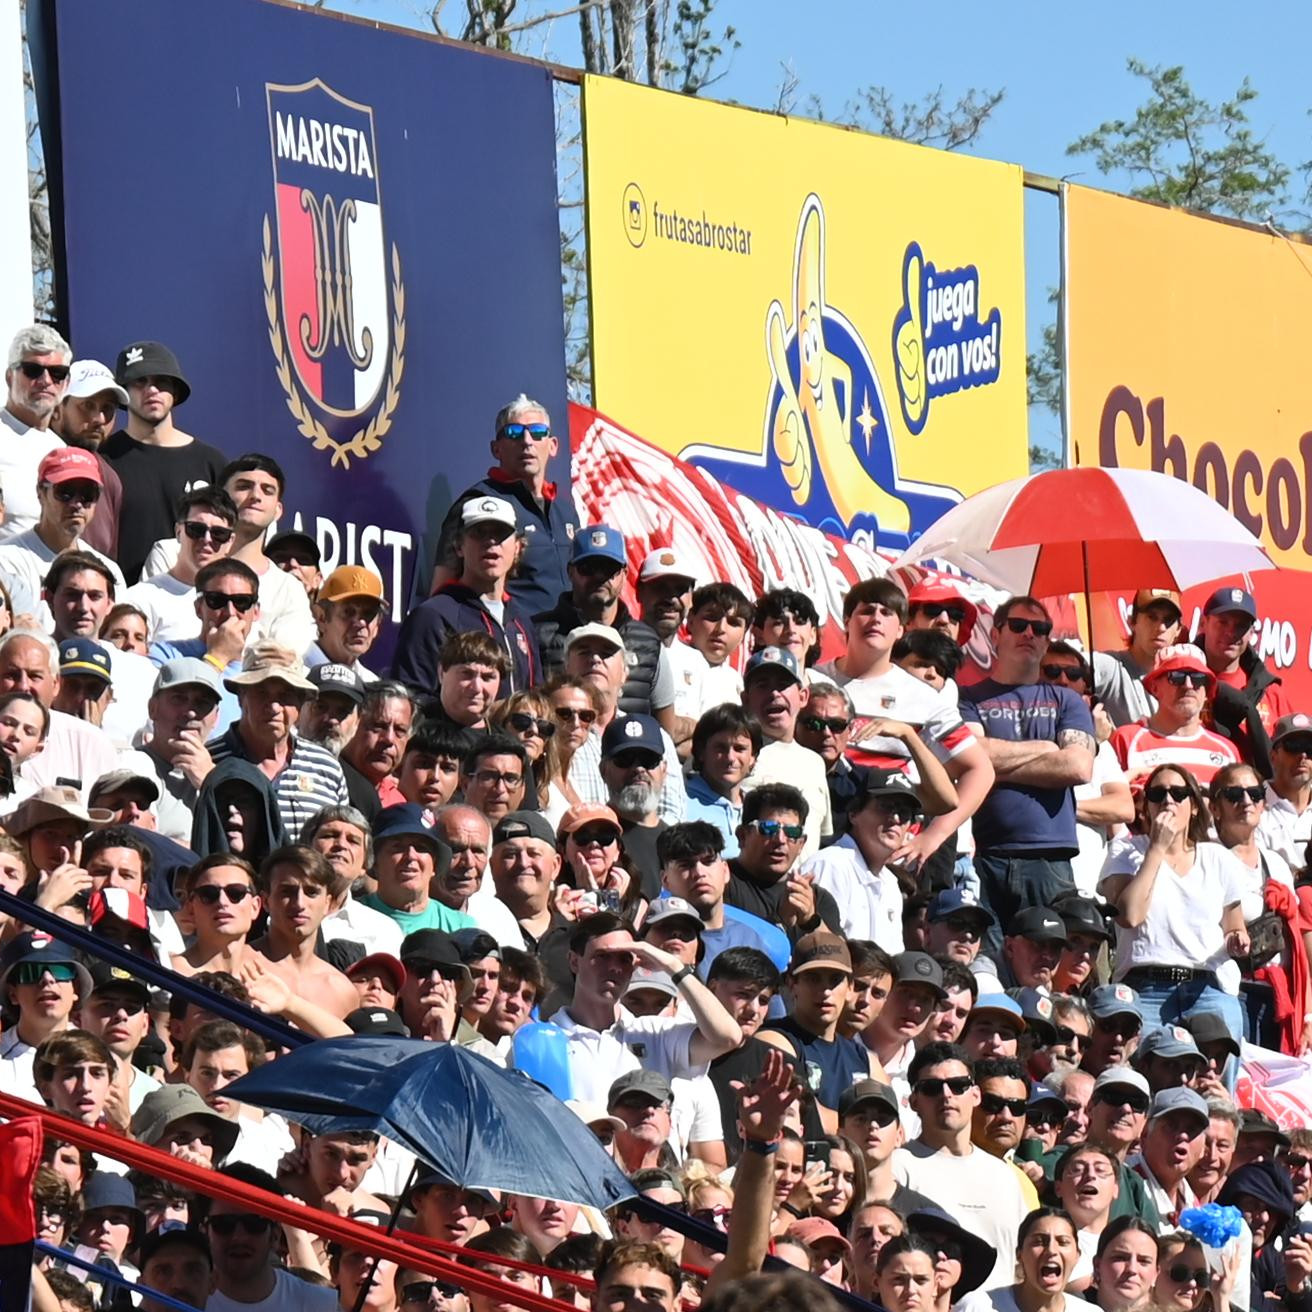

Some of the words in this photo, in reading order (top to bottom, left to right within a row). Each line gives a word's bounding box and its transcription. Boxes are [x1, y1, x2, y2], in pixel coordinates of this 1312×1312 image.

[276, 111, 374, 180] MARISTA
[653, 210, 753, 257] frutasabrostar
[925, 278, 976, 338] juega
[925, 346, 958, 385] con
[962, 325, 998, 376] vos!
